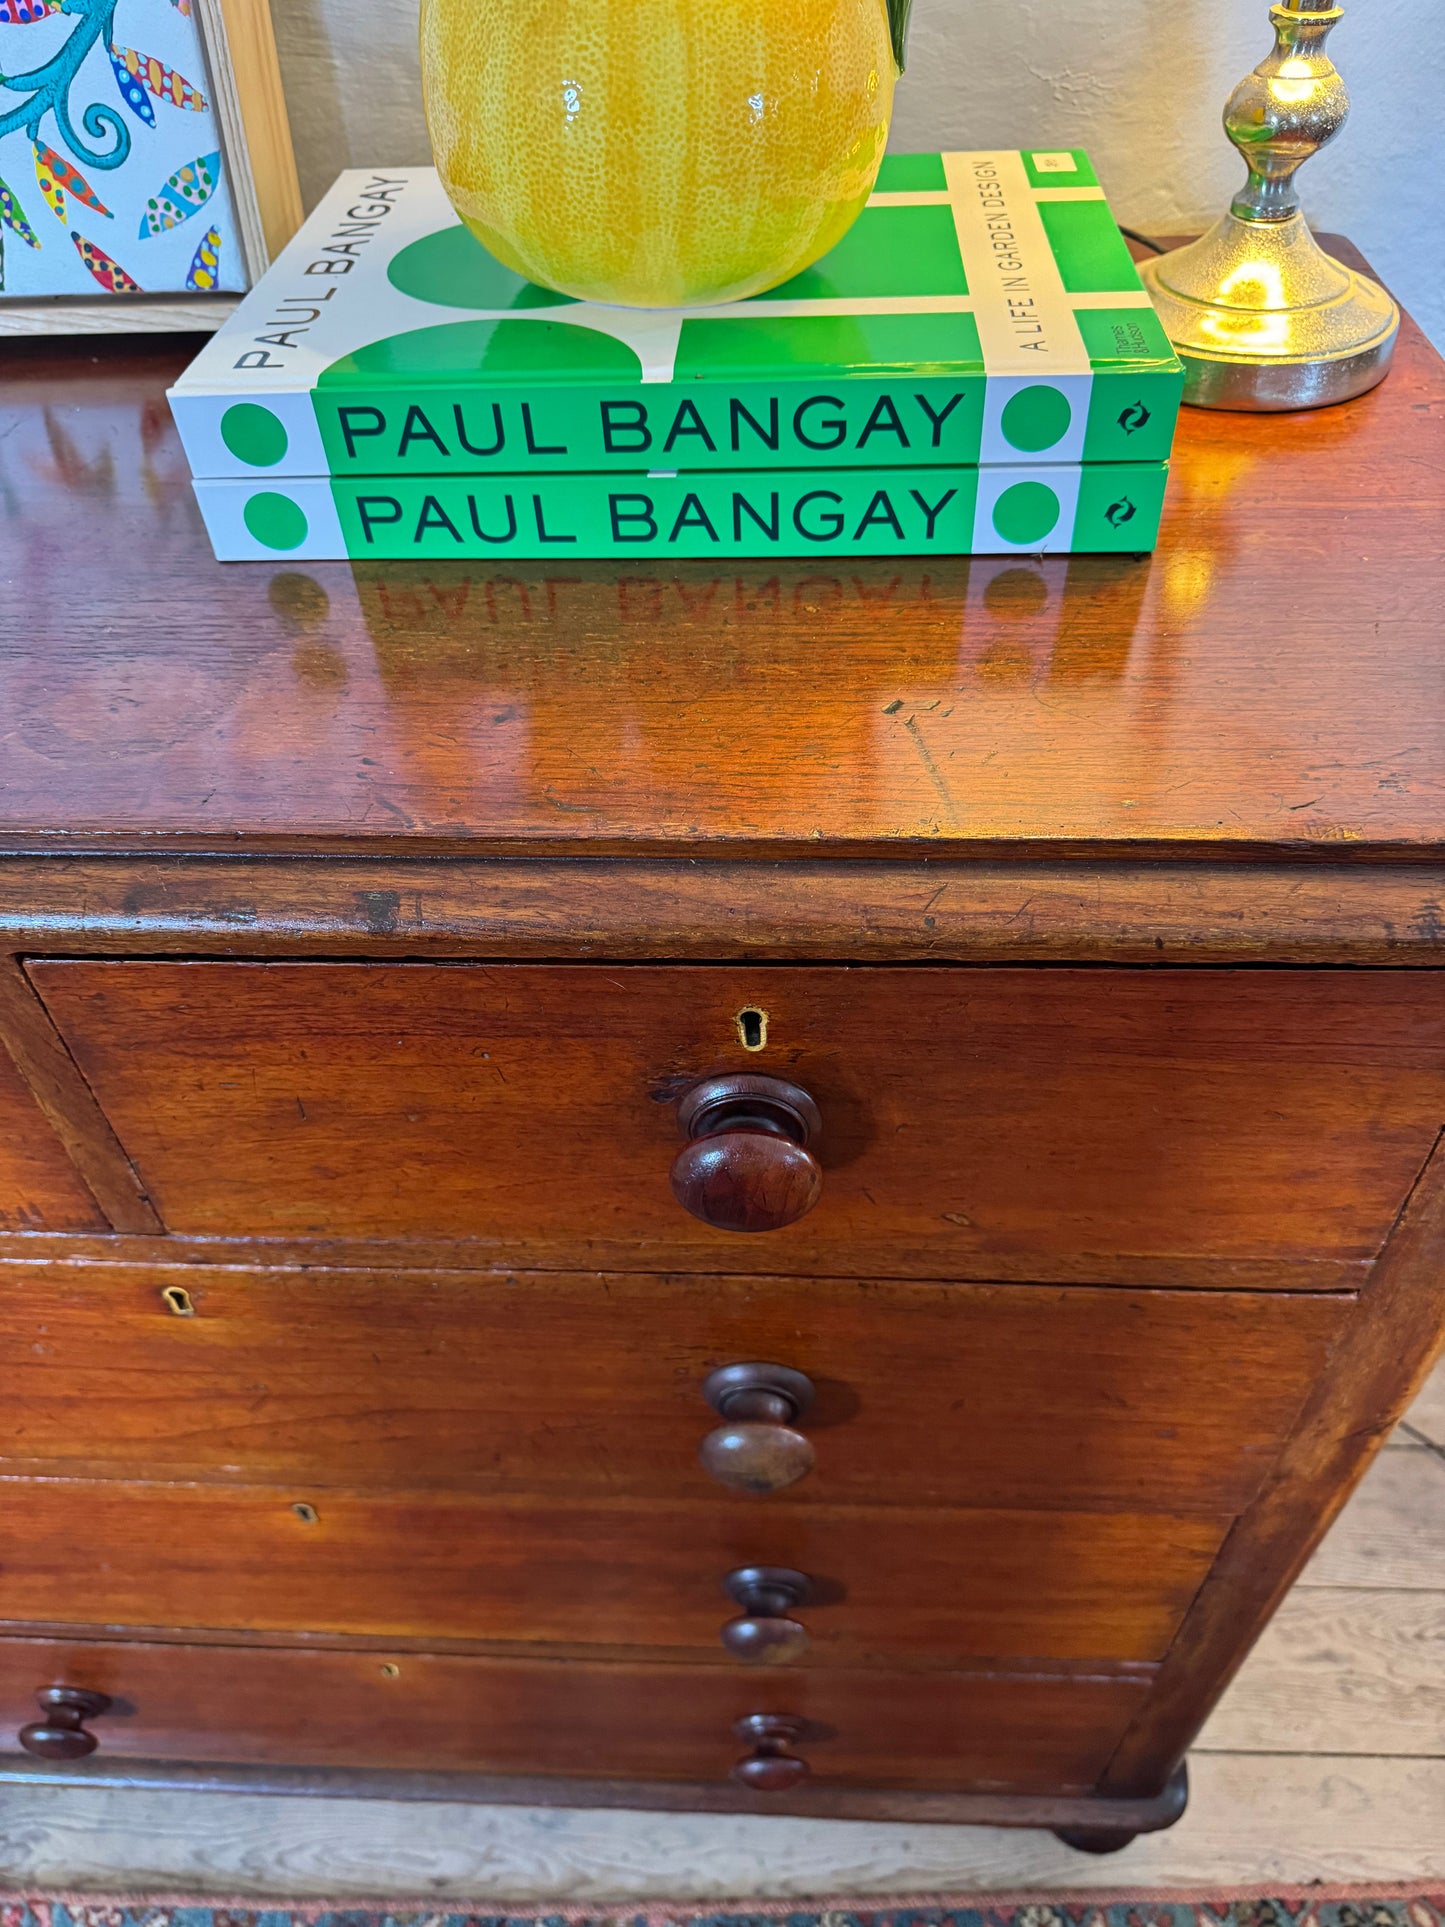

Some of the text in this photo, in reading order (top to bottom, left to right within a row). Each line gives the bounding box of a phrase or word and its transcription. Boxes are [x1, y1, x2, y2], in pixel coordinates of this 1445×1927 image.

[233, 176, 409, 370] PAUL BANGAY
[972, 161, 1049, 352] A LIFE IN GARDEN DESIGN
[337, 393, 966, 459] PAUL BANGAY
[355, 488, 959, 544] PAUL BANGAY
